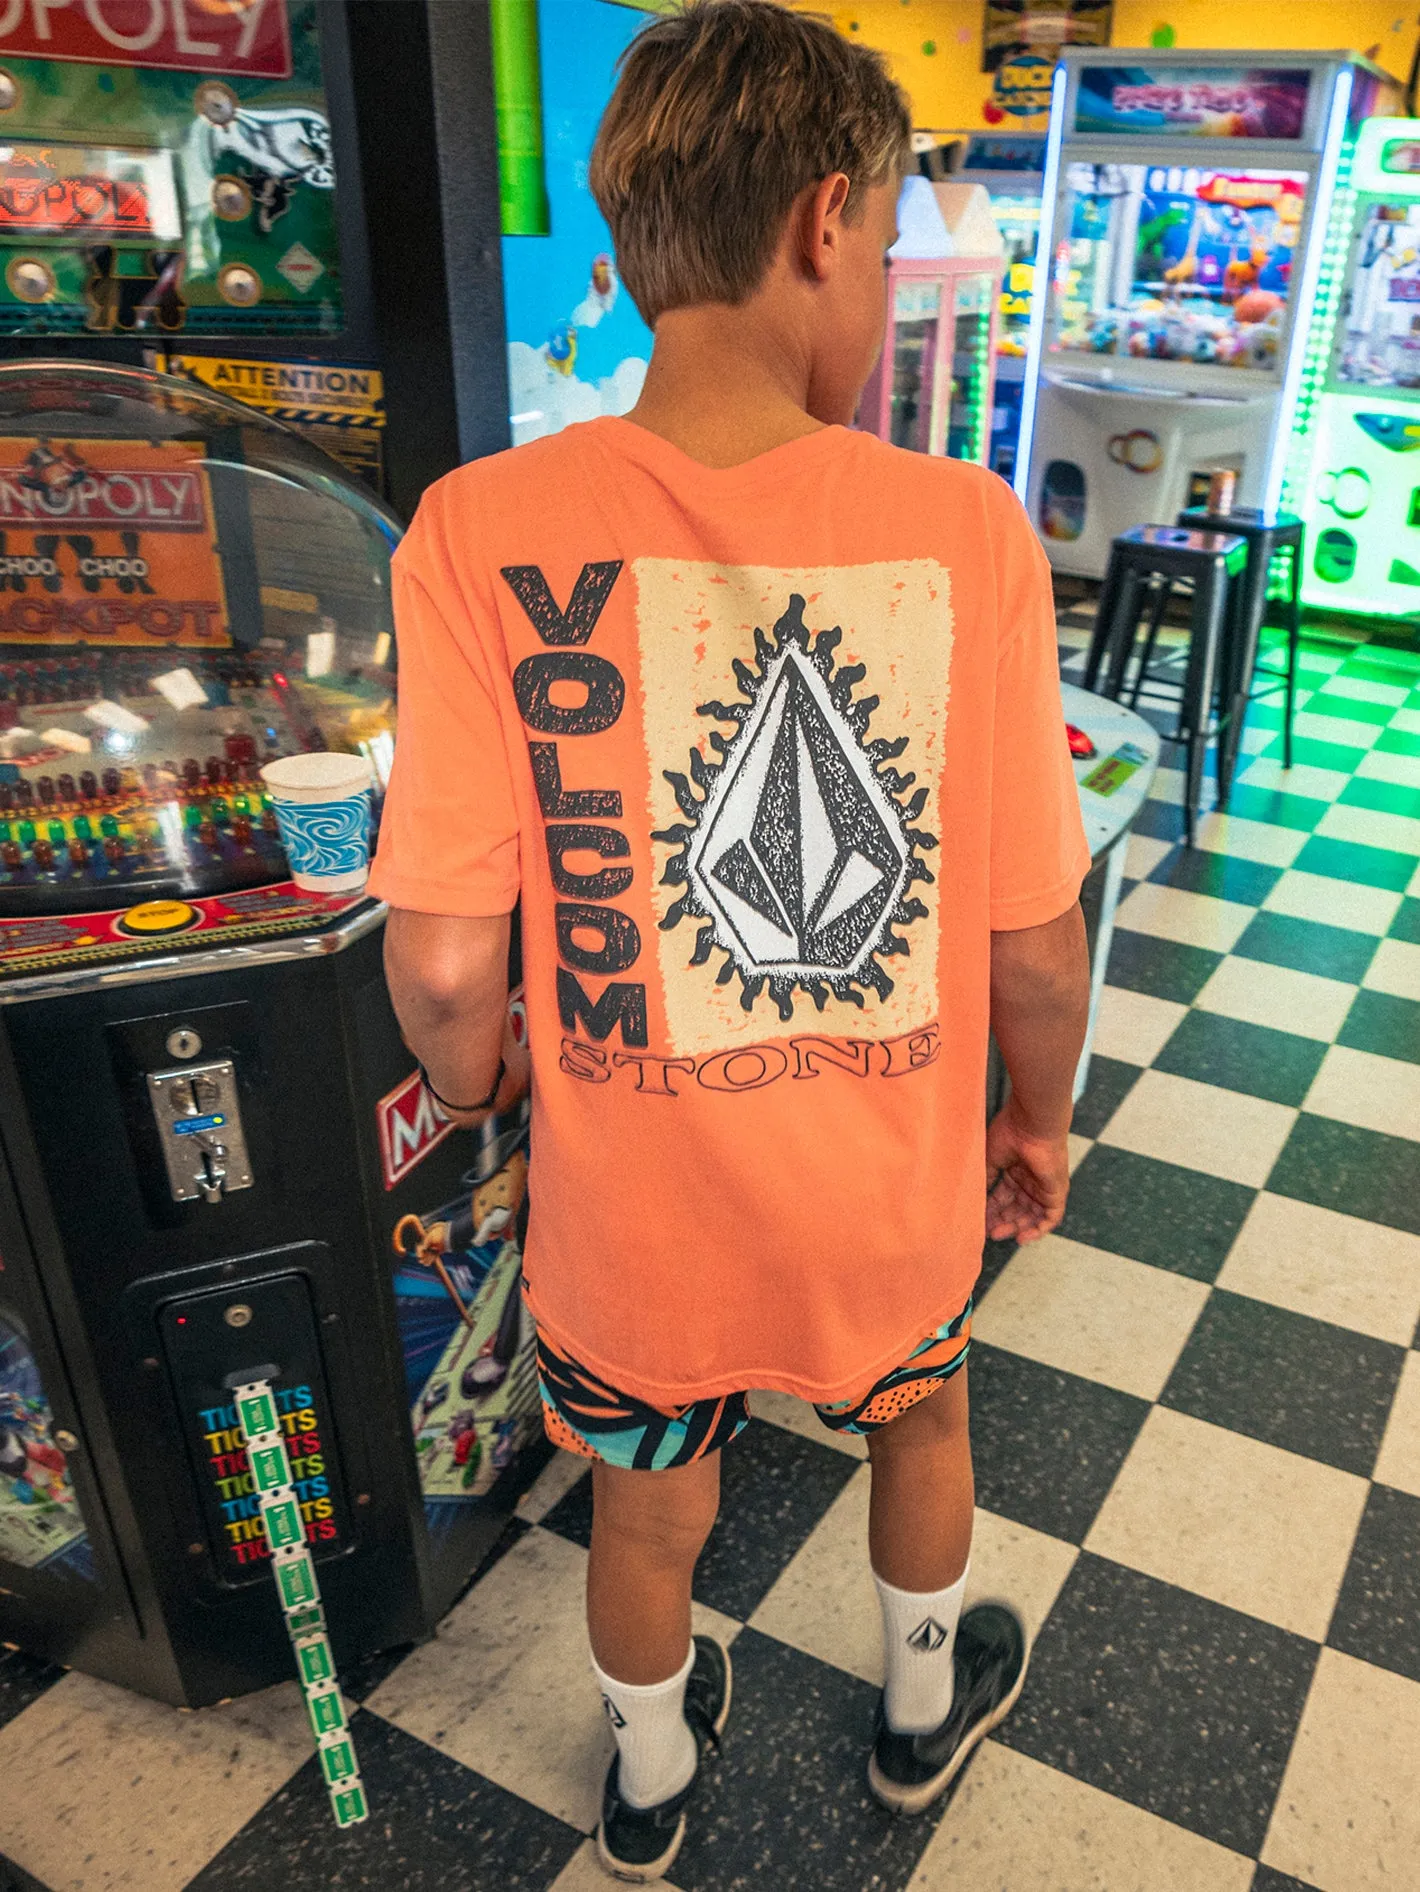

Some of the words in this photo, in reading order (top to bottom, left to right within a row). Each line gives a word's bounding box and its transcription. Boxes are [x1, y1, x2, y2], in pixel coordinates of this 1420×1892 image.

[214, 363, 370, 394] ATTENTION
[79, 558, 147, 577] CHOO
[500, 560, 649, 1047] VOLCOM
[559, 1022, 942, 1097] STONE
[203, 1408, 318, 1455] TICTS
[224, 1497, 334, 1543] TICTS
